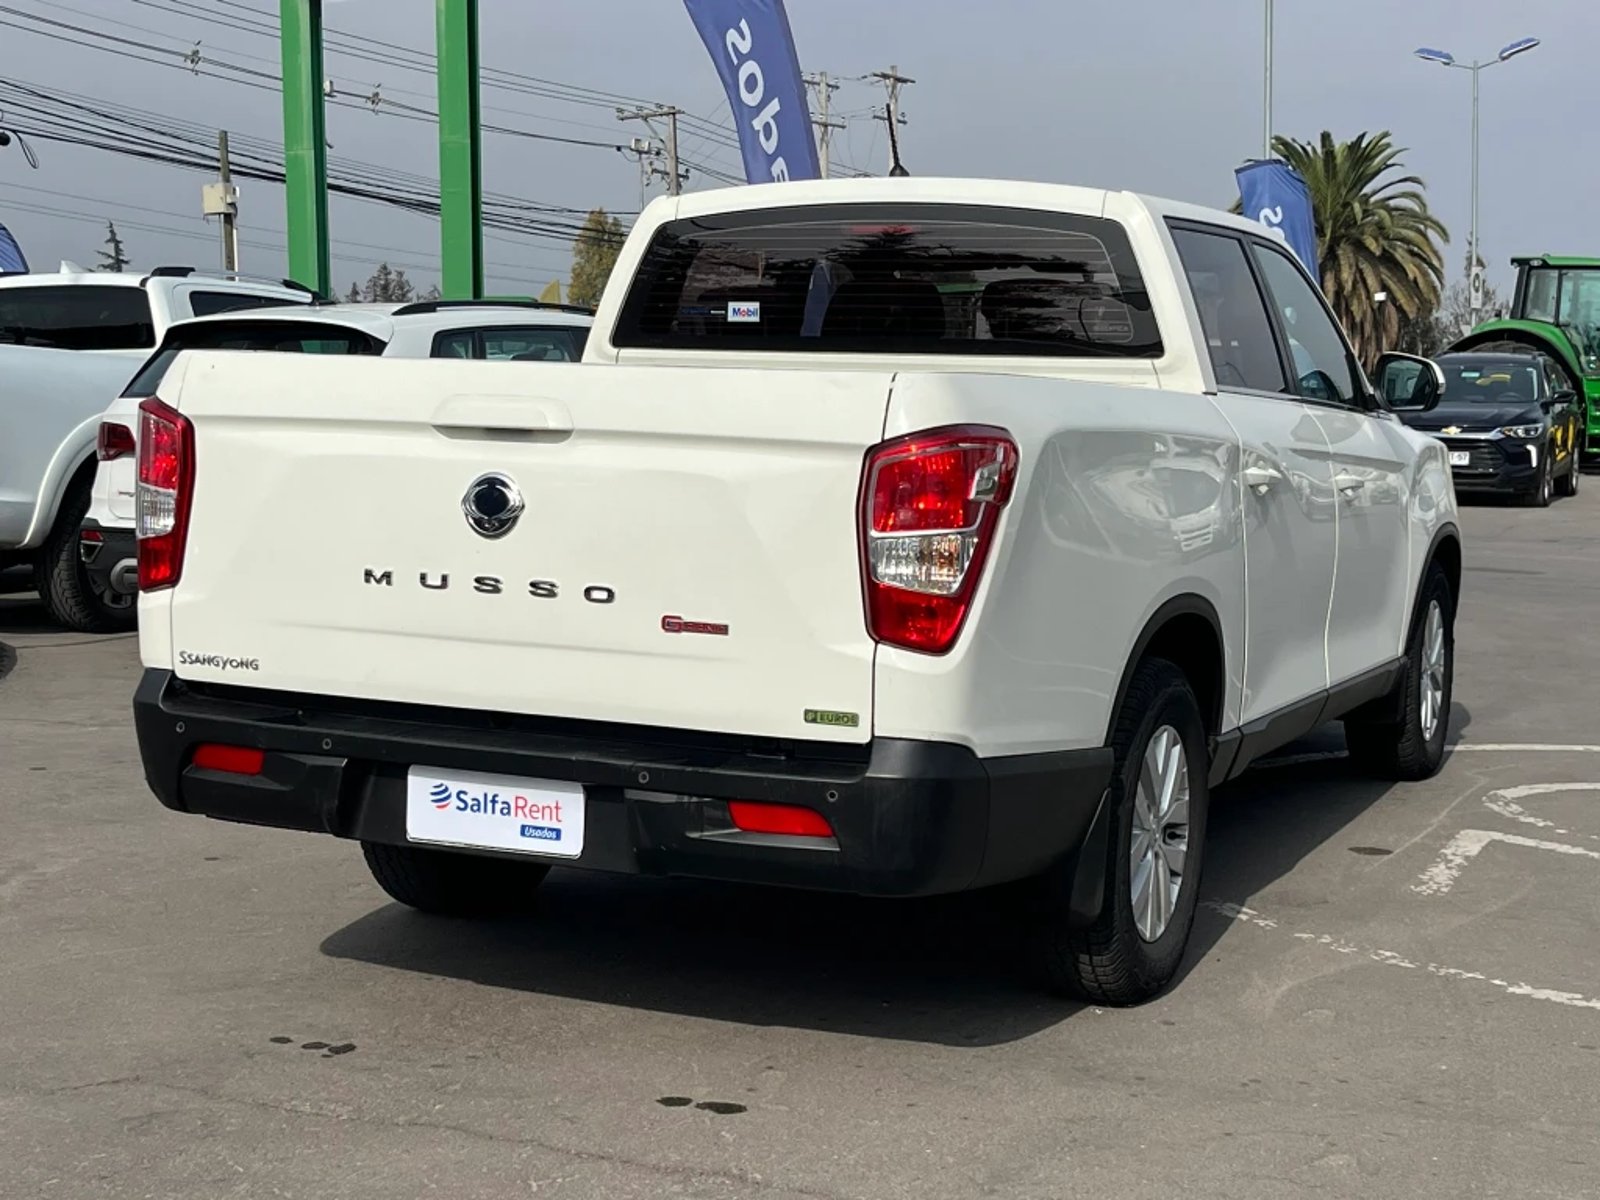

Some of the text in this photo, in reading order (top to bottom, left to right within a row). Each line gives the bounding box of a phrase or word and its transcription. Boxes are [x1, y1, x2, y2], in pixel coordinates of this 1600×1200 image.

[732, 307, 758, 317] Mobil
[363, 568, 616, 605] MUSSO
[178, 650, 260, 671] SSANGYONG
[455, 790, 563, 823] SalfaRent
[523, 826, 557, 840] Usados
